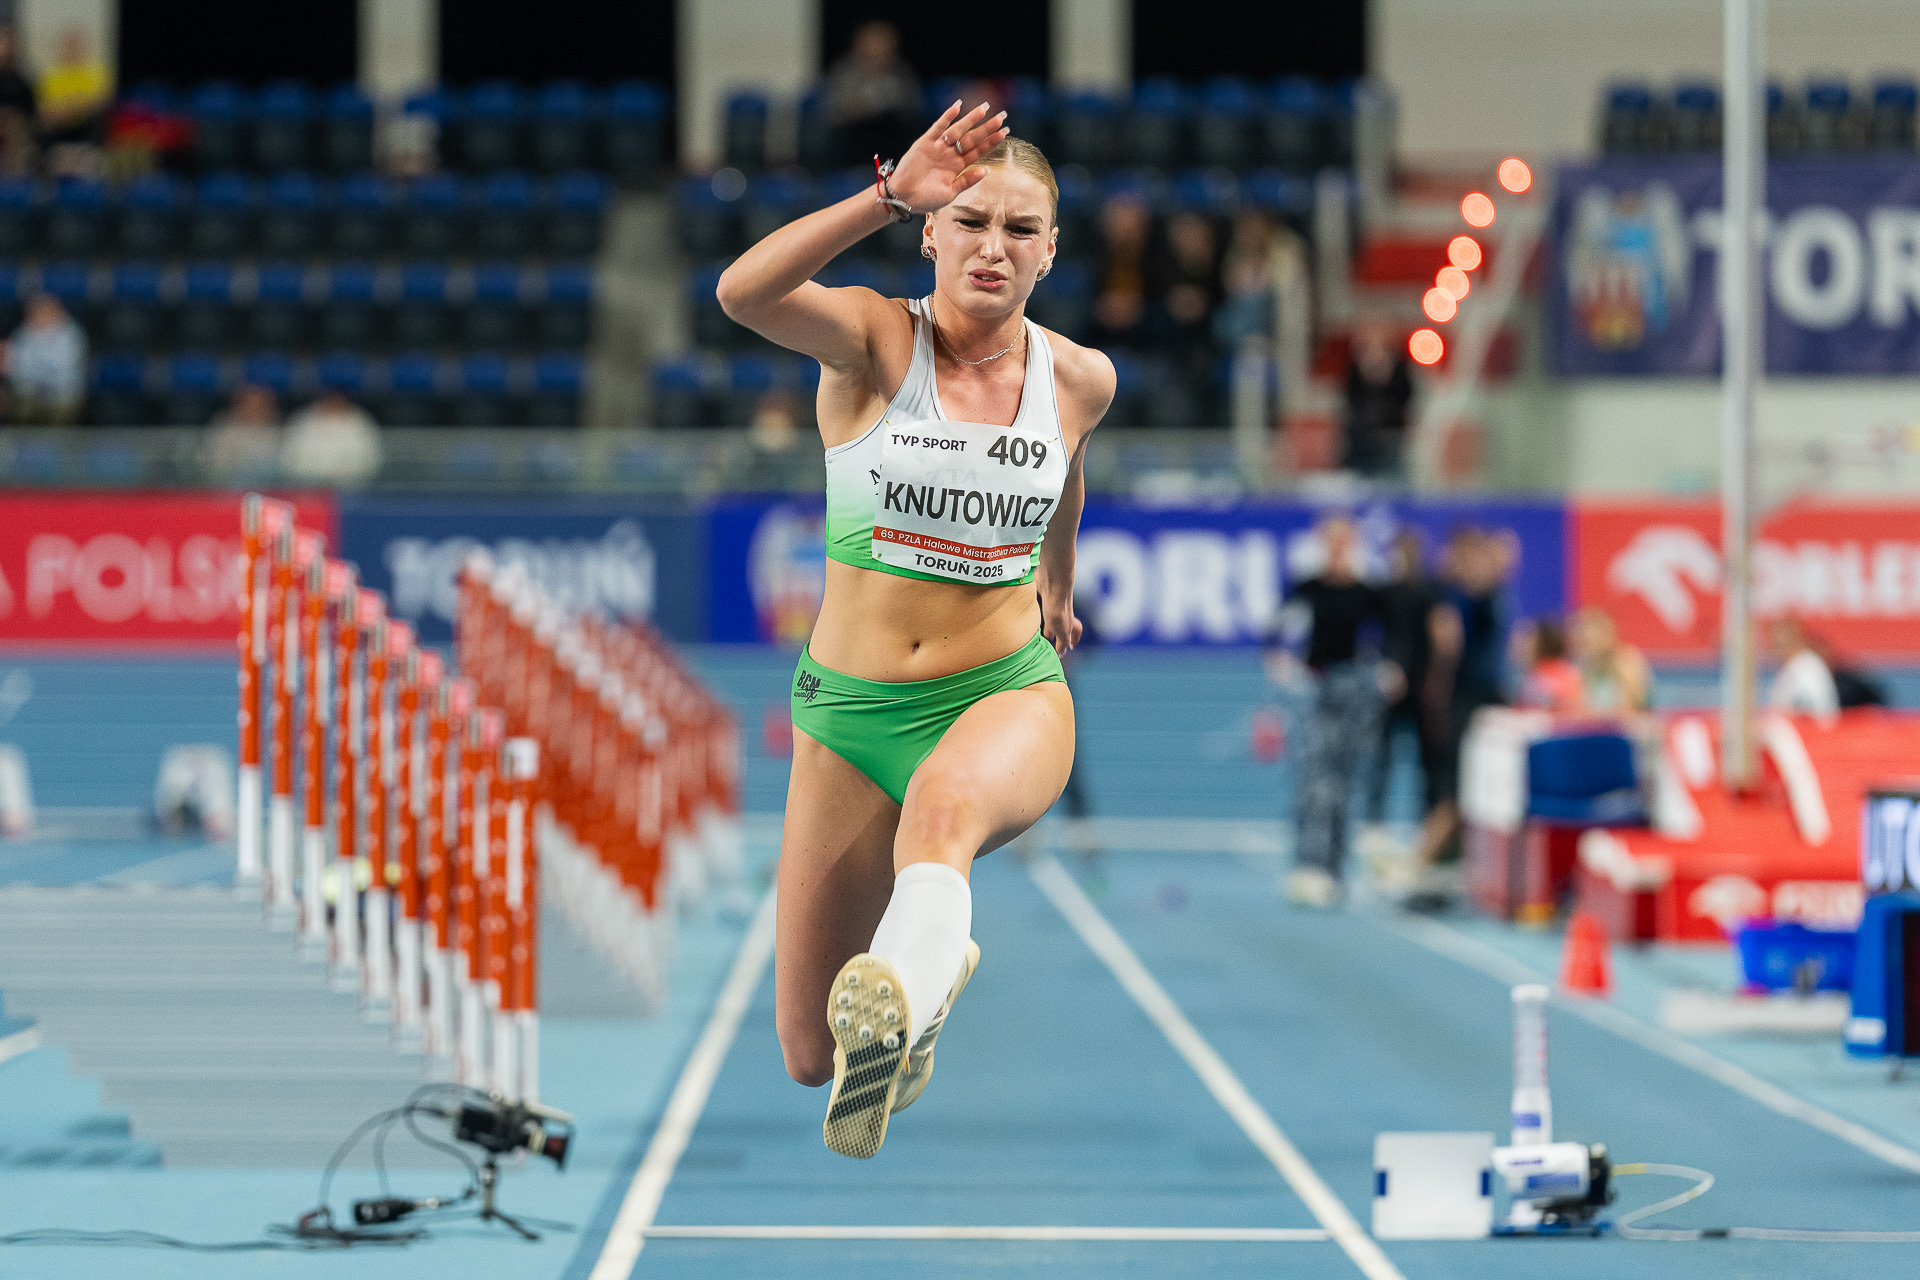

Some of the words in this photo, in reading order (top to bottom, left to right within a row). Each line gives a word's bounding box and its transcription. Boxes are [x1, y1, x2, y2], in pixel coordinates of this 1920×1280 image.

[891, 434, 919, 445] TVP
[922, 437, 967, 451] SPORT
[987, 435, 1047, 469] 409
[884, 481, 1055, 528] KNUTOWICZ
[880, 529, 896, 540] 69.
[898, 533, 921, 546] PZLA
[923, 536, 961, 554] Halowe
[1008, 544, 1030, 555] Polski
[26, 533, 248, 622] POLS
[915, 553, 970, 575] TORUŃ
[972, 564, 1003, 578] 2025
